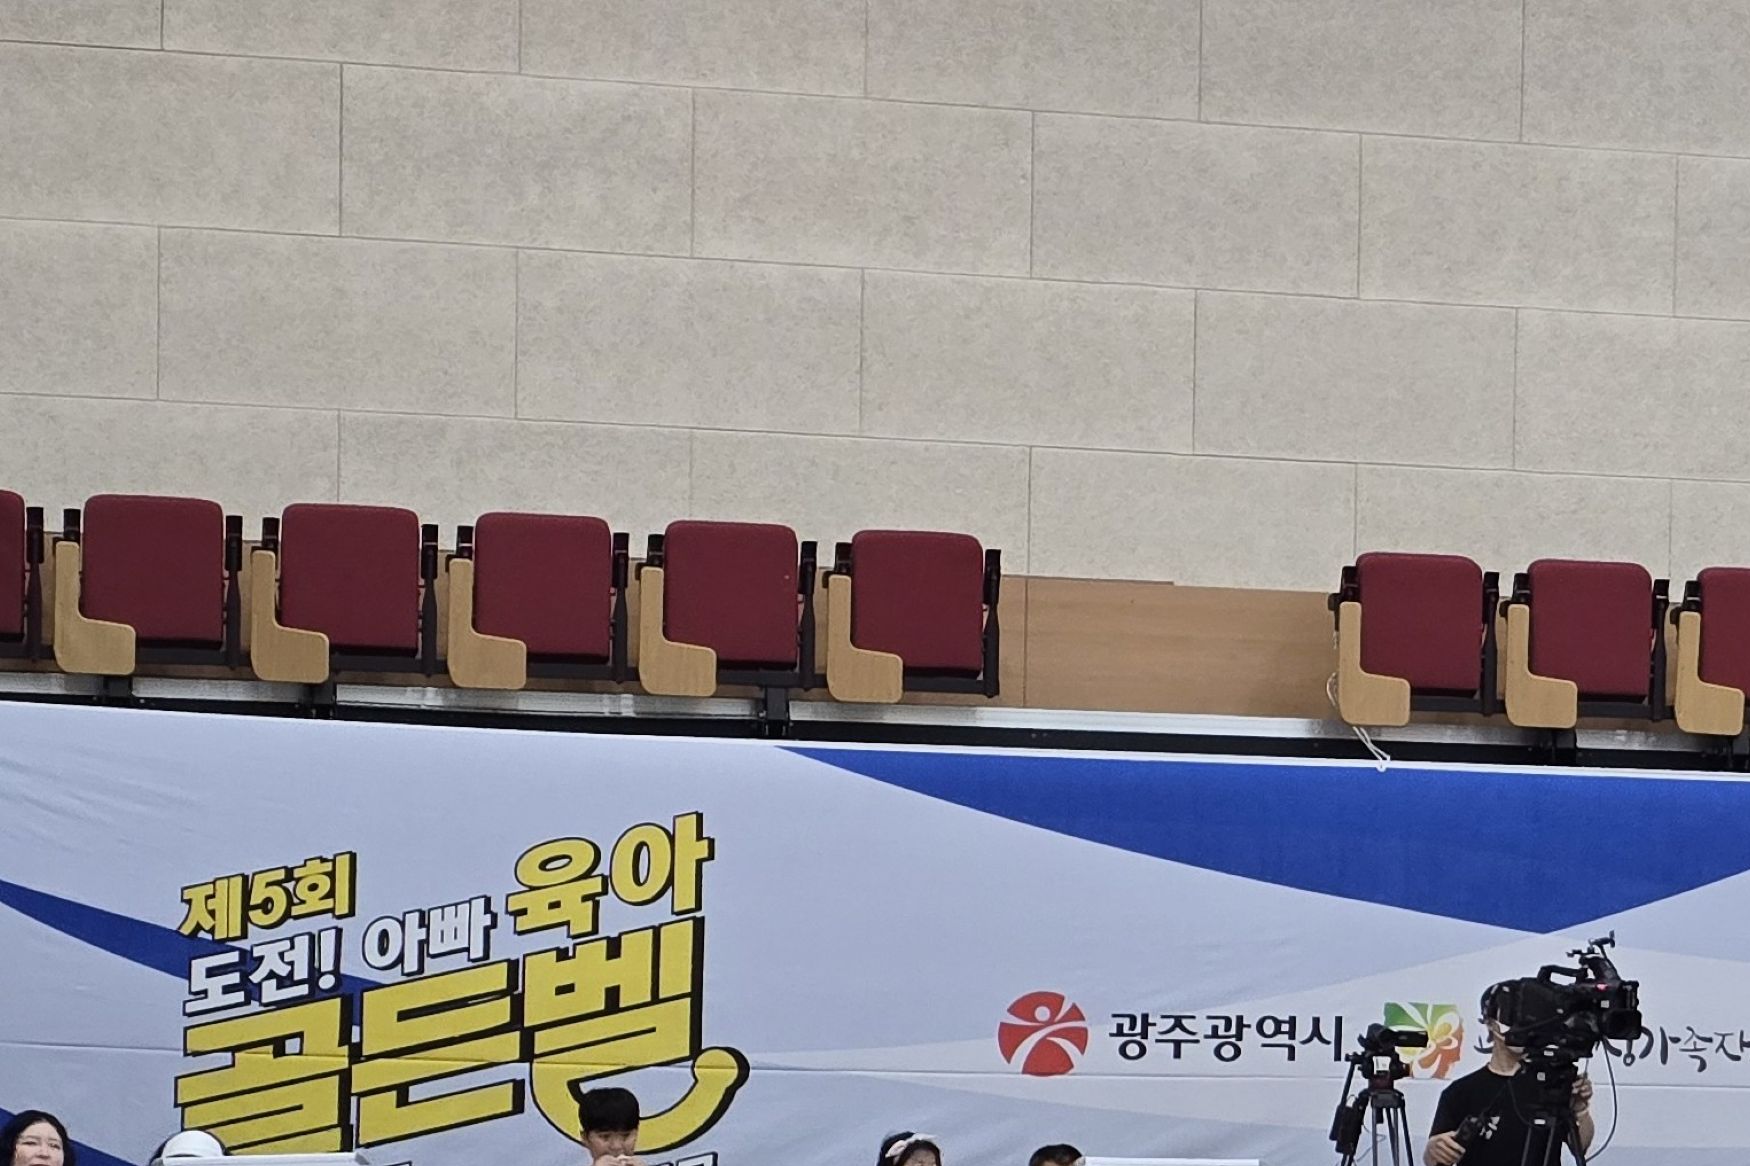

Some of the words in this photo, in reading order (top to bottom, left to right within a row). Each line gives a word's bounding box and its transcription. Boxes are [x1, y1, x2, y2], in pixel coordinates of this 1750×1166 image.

[180, 851, 356, 941] 제5회
[182, 927, 342, 1016] 도전!
[362, 895, 497, 976] 아빠
[507, 811, 714, 937] 육아
[175, 917, 750, 1154] 골든벨
[1108, 1012, 1344, 1064] 광주광역시
